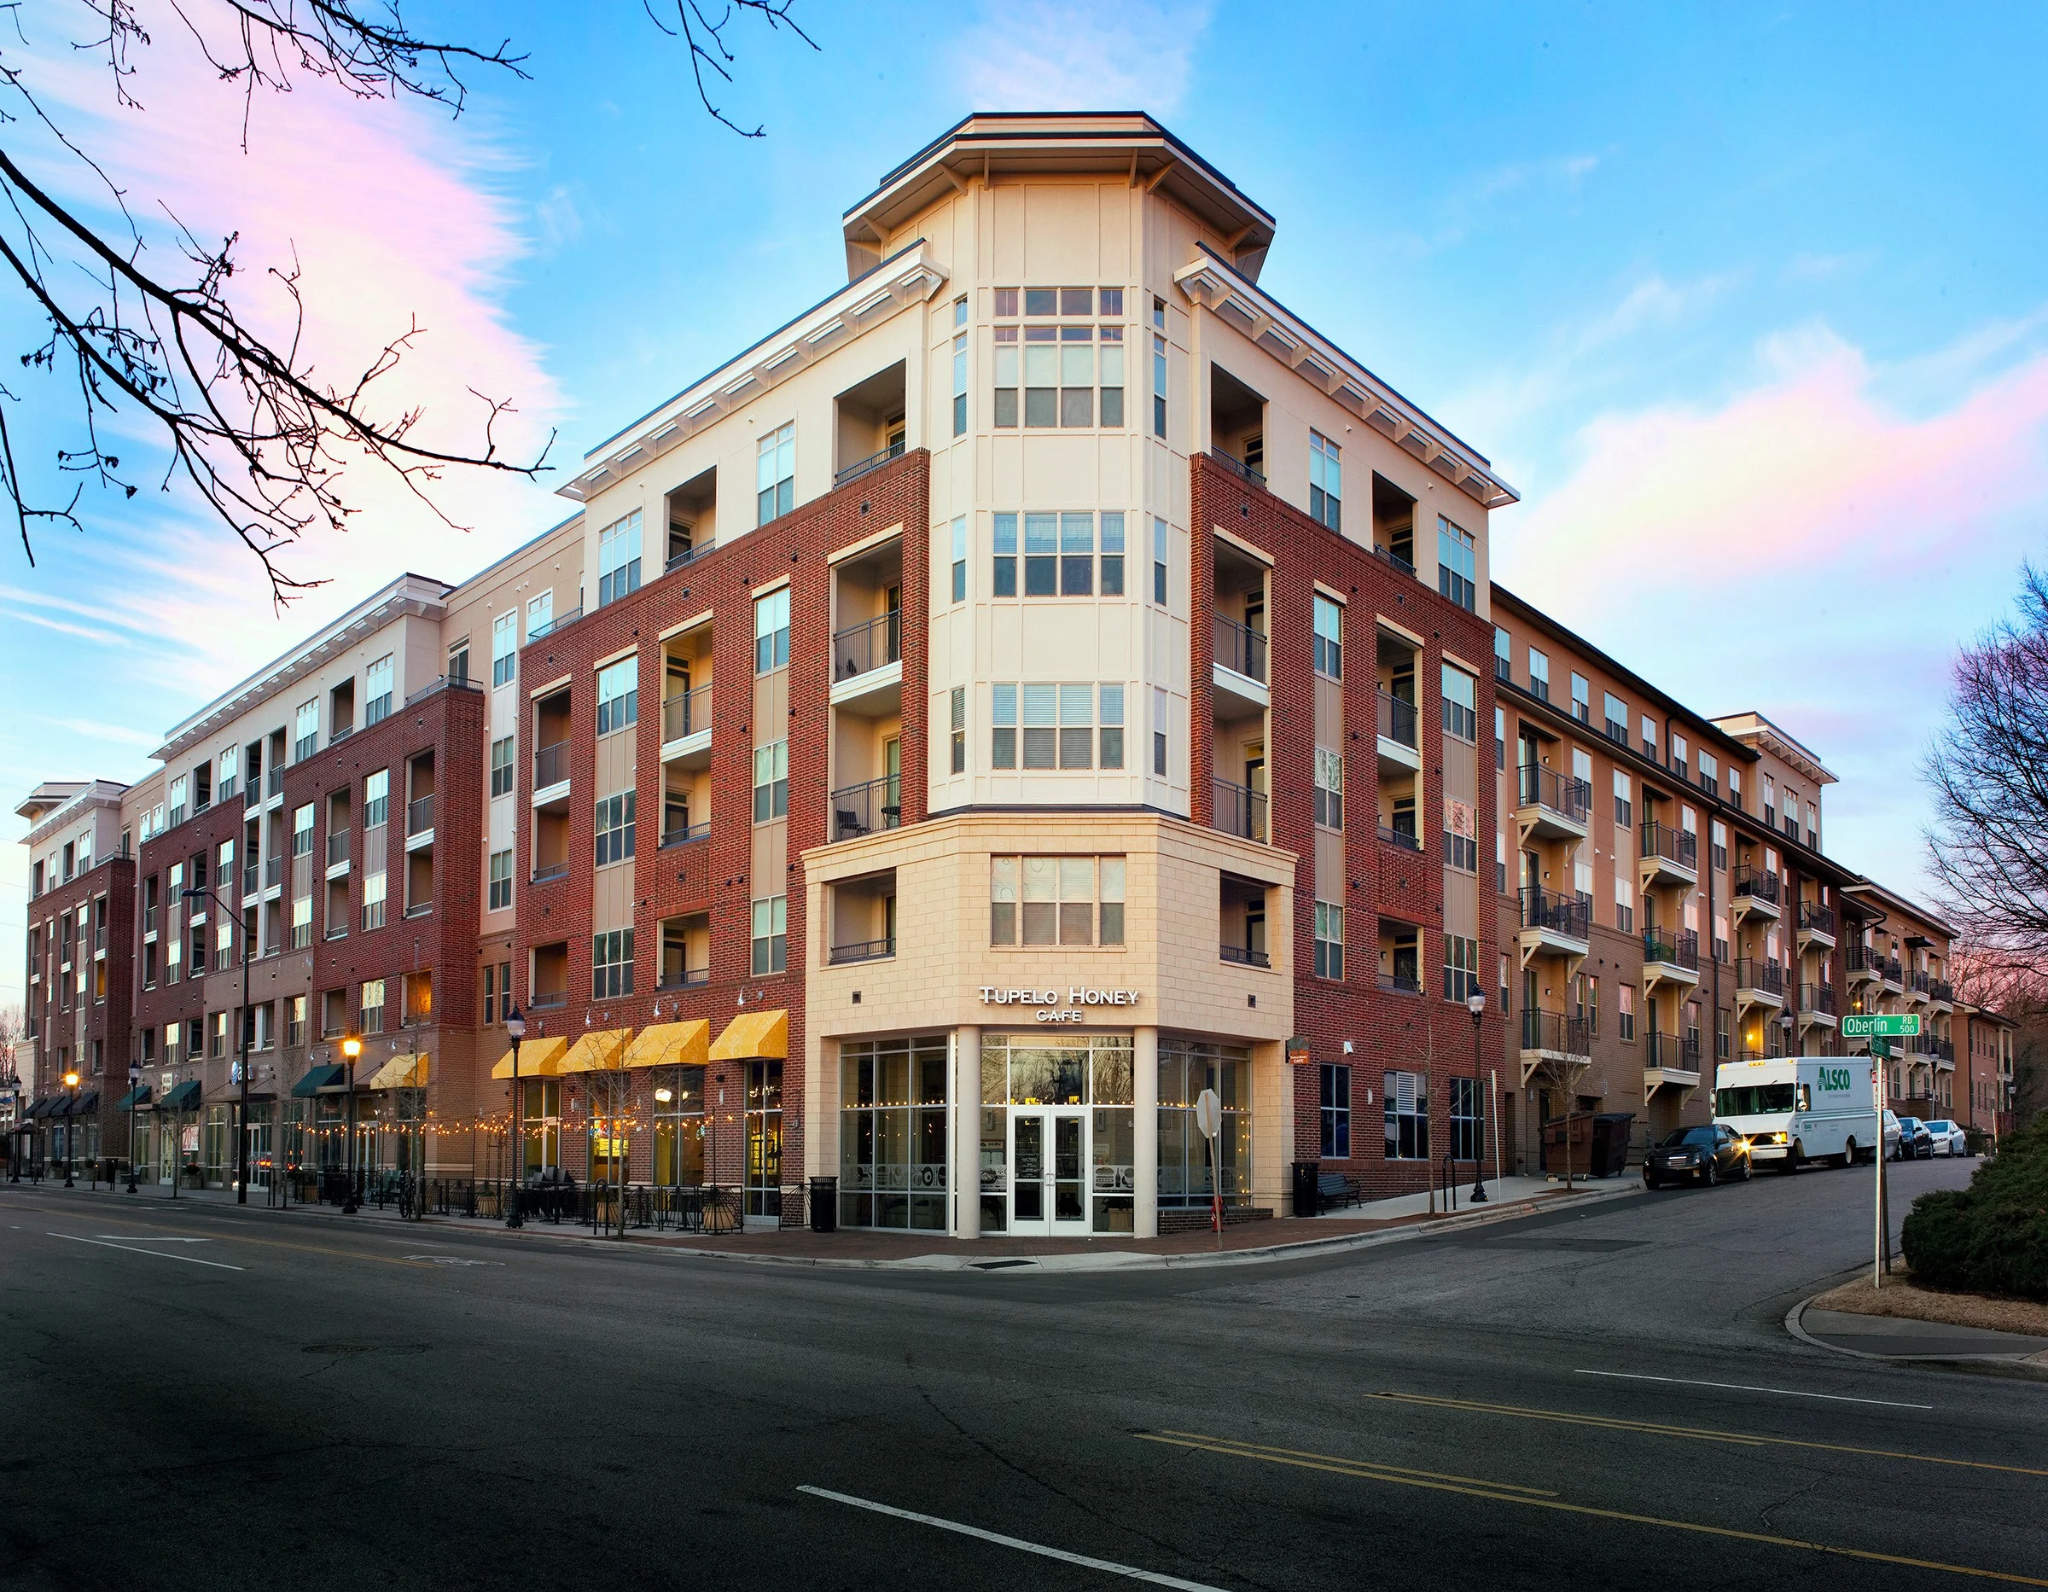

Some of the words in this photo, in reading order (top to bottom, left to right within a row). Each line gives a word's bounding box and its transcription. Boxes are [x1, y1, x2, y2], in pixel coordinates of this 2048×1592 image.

[979, 986, 1058, 1004] TUPELO
[1069, 986, 1139, 1005] HONEY
[1035, 1009, 1082, 1022] CAFE
[1847, 1018, 1887, 1033] Oberlin
[1902, 1016, 1912, 1024] RD
[1899, 1025, 1914, 1033] 500
[1818, 1066, 1850, 1091] ALSCO
